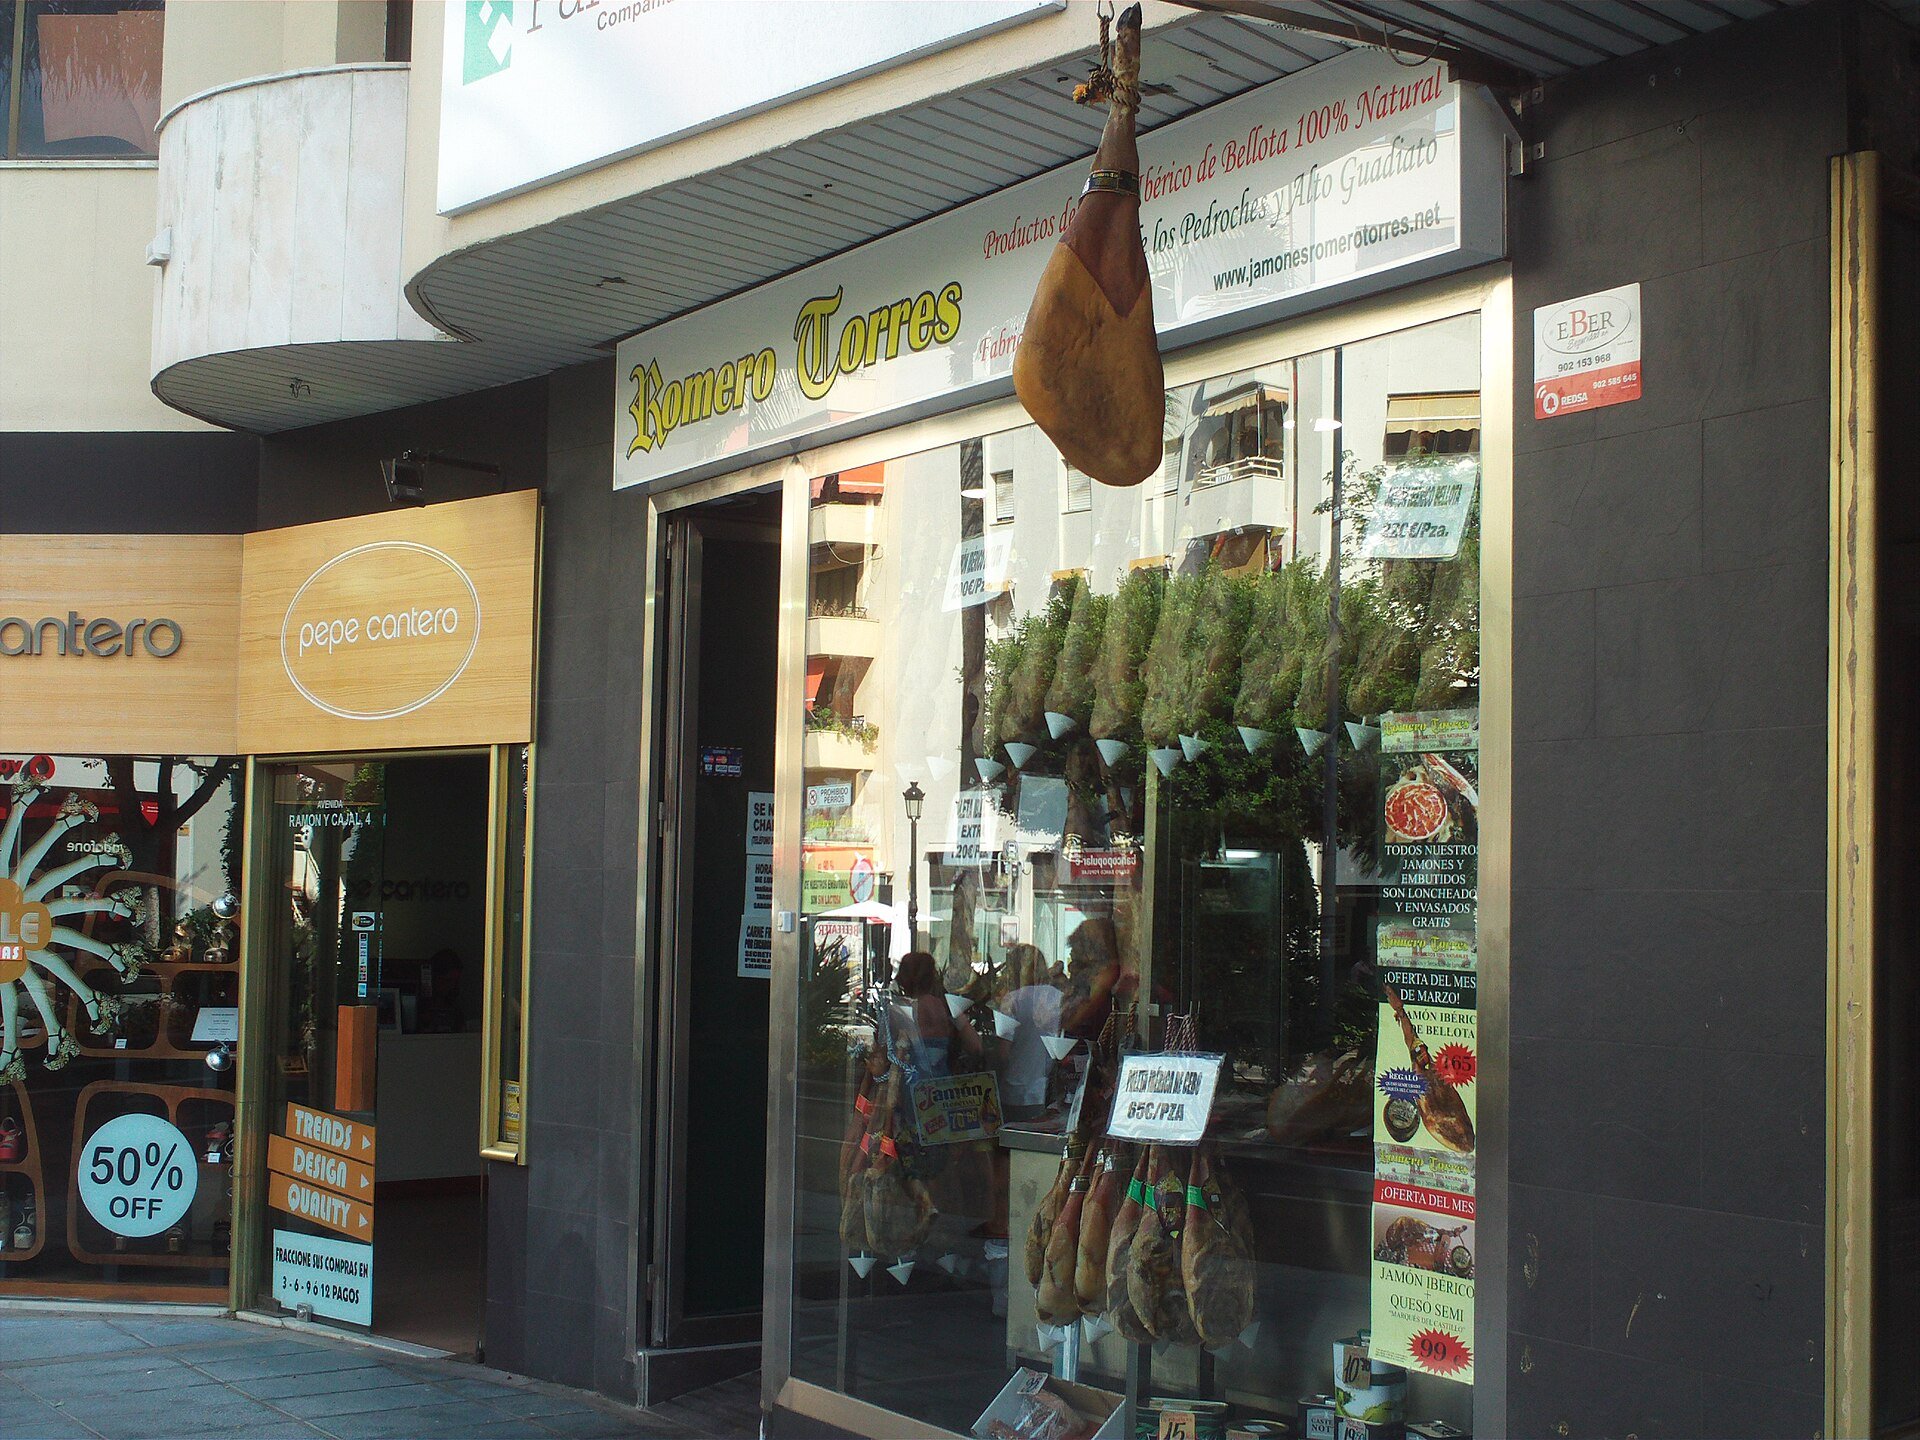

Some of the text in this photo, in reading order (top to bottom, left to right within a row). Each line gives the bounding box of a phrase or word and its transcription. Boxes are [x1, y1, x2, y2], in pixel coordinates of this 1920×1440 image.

[983, 215, 1056, 260] Productos
[1197, 143, 1217, 183] de
[1221, 124, 1289, 174] Bellota
[1295, 99, 1349, 149] 100%
[1355, 65, 1443, 130] Natural
[1153, 217, 1176, 253] los
[1180, 187, 1268, 246] Pedroches
[1270, 191, 1285, 229] y
[1286, 164, 1333, 215] Alto
[1340, 135, 1438, 206] Guadiato
[1213, 200, 1441, 291] www.jamonesromerotorres.net
[1557, 309, 1615, 341] EBER
[626, 281, 964, 460] Romero Torres
[1558, 361, 1574, 372] 902
[1577, 356, 1593, 368] 153
[1593, 380, 1606, 389] 902
[1561, 392, 1588, 406] REDSA
[0, 611, 184, 658] antero
[299, 607, 458, 658] pepe cantero
[821, 787, 848, 796] PROHIBIDO
[823, 795, 845, 804] PERROS
[317, 799, 344, 809] AVENIDA
[753, 803, 766, 816] SE
[289, 813, 322, 828] RAMON
[324, 814, 331, 828] Y
[364, 813, 371, 826] 4
[1385, 845, 1422, 855] TODOS
[1402, 860, 1464, 870] JAMONES Y
[1401, 874, 1466, 885] EMBUTIDOS
[1383, 888, 1405, 898] SON
[1395, 902, 1470, 914] Y ENVASADOS
[1412, 917, 1450, 928] GRATIS
[1384, 971, 1476, 989] ¡OFERTA DEL MES
[1400, 988, 1460, 1005] DE MARZO!
[1404, 1009, 1477, 1025] AMÓN IBÉRIC
[1426, 1027, 1475, 1039] BELLOTA
[1389, 1073, 1418, 1082] REGALO
[294, 1108, 353, 1150] TRENDS
[90, 1142, 183, 1191] 50%
[292, 1146, 347, 1188] DESIGN
[109, 1196, 163, 1219] OFF
[287, 1183, 351, 1228] QUALITY
[1381, 1187, 1474, 1214] ¡OFERTA DEL MES
[276, 1247, 369, 1278] FRACCIONE SUS COMPRAS EN
[282, 1275, 287, 1290] 3
[294, 1277, 299, 1292] 6
[306, 1279, 311, 1294] 9
[321, 1283, 330, 1298] 12
[332, 1284, 360, 1305] PAGOS
[1380, 1267, 1475, 1298] JAMÓN IBÉRICO
[1390, 1294, 1464, 1322] QUESO SEMI
[1421, 1317, 1433, 1326] DEL
[1420, 1338, 1447, 1361] 99
[1311, 1417, 1335, 1426] CASTE
